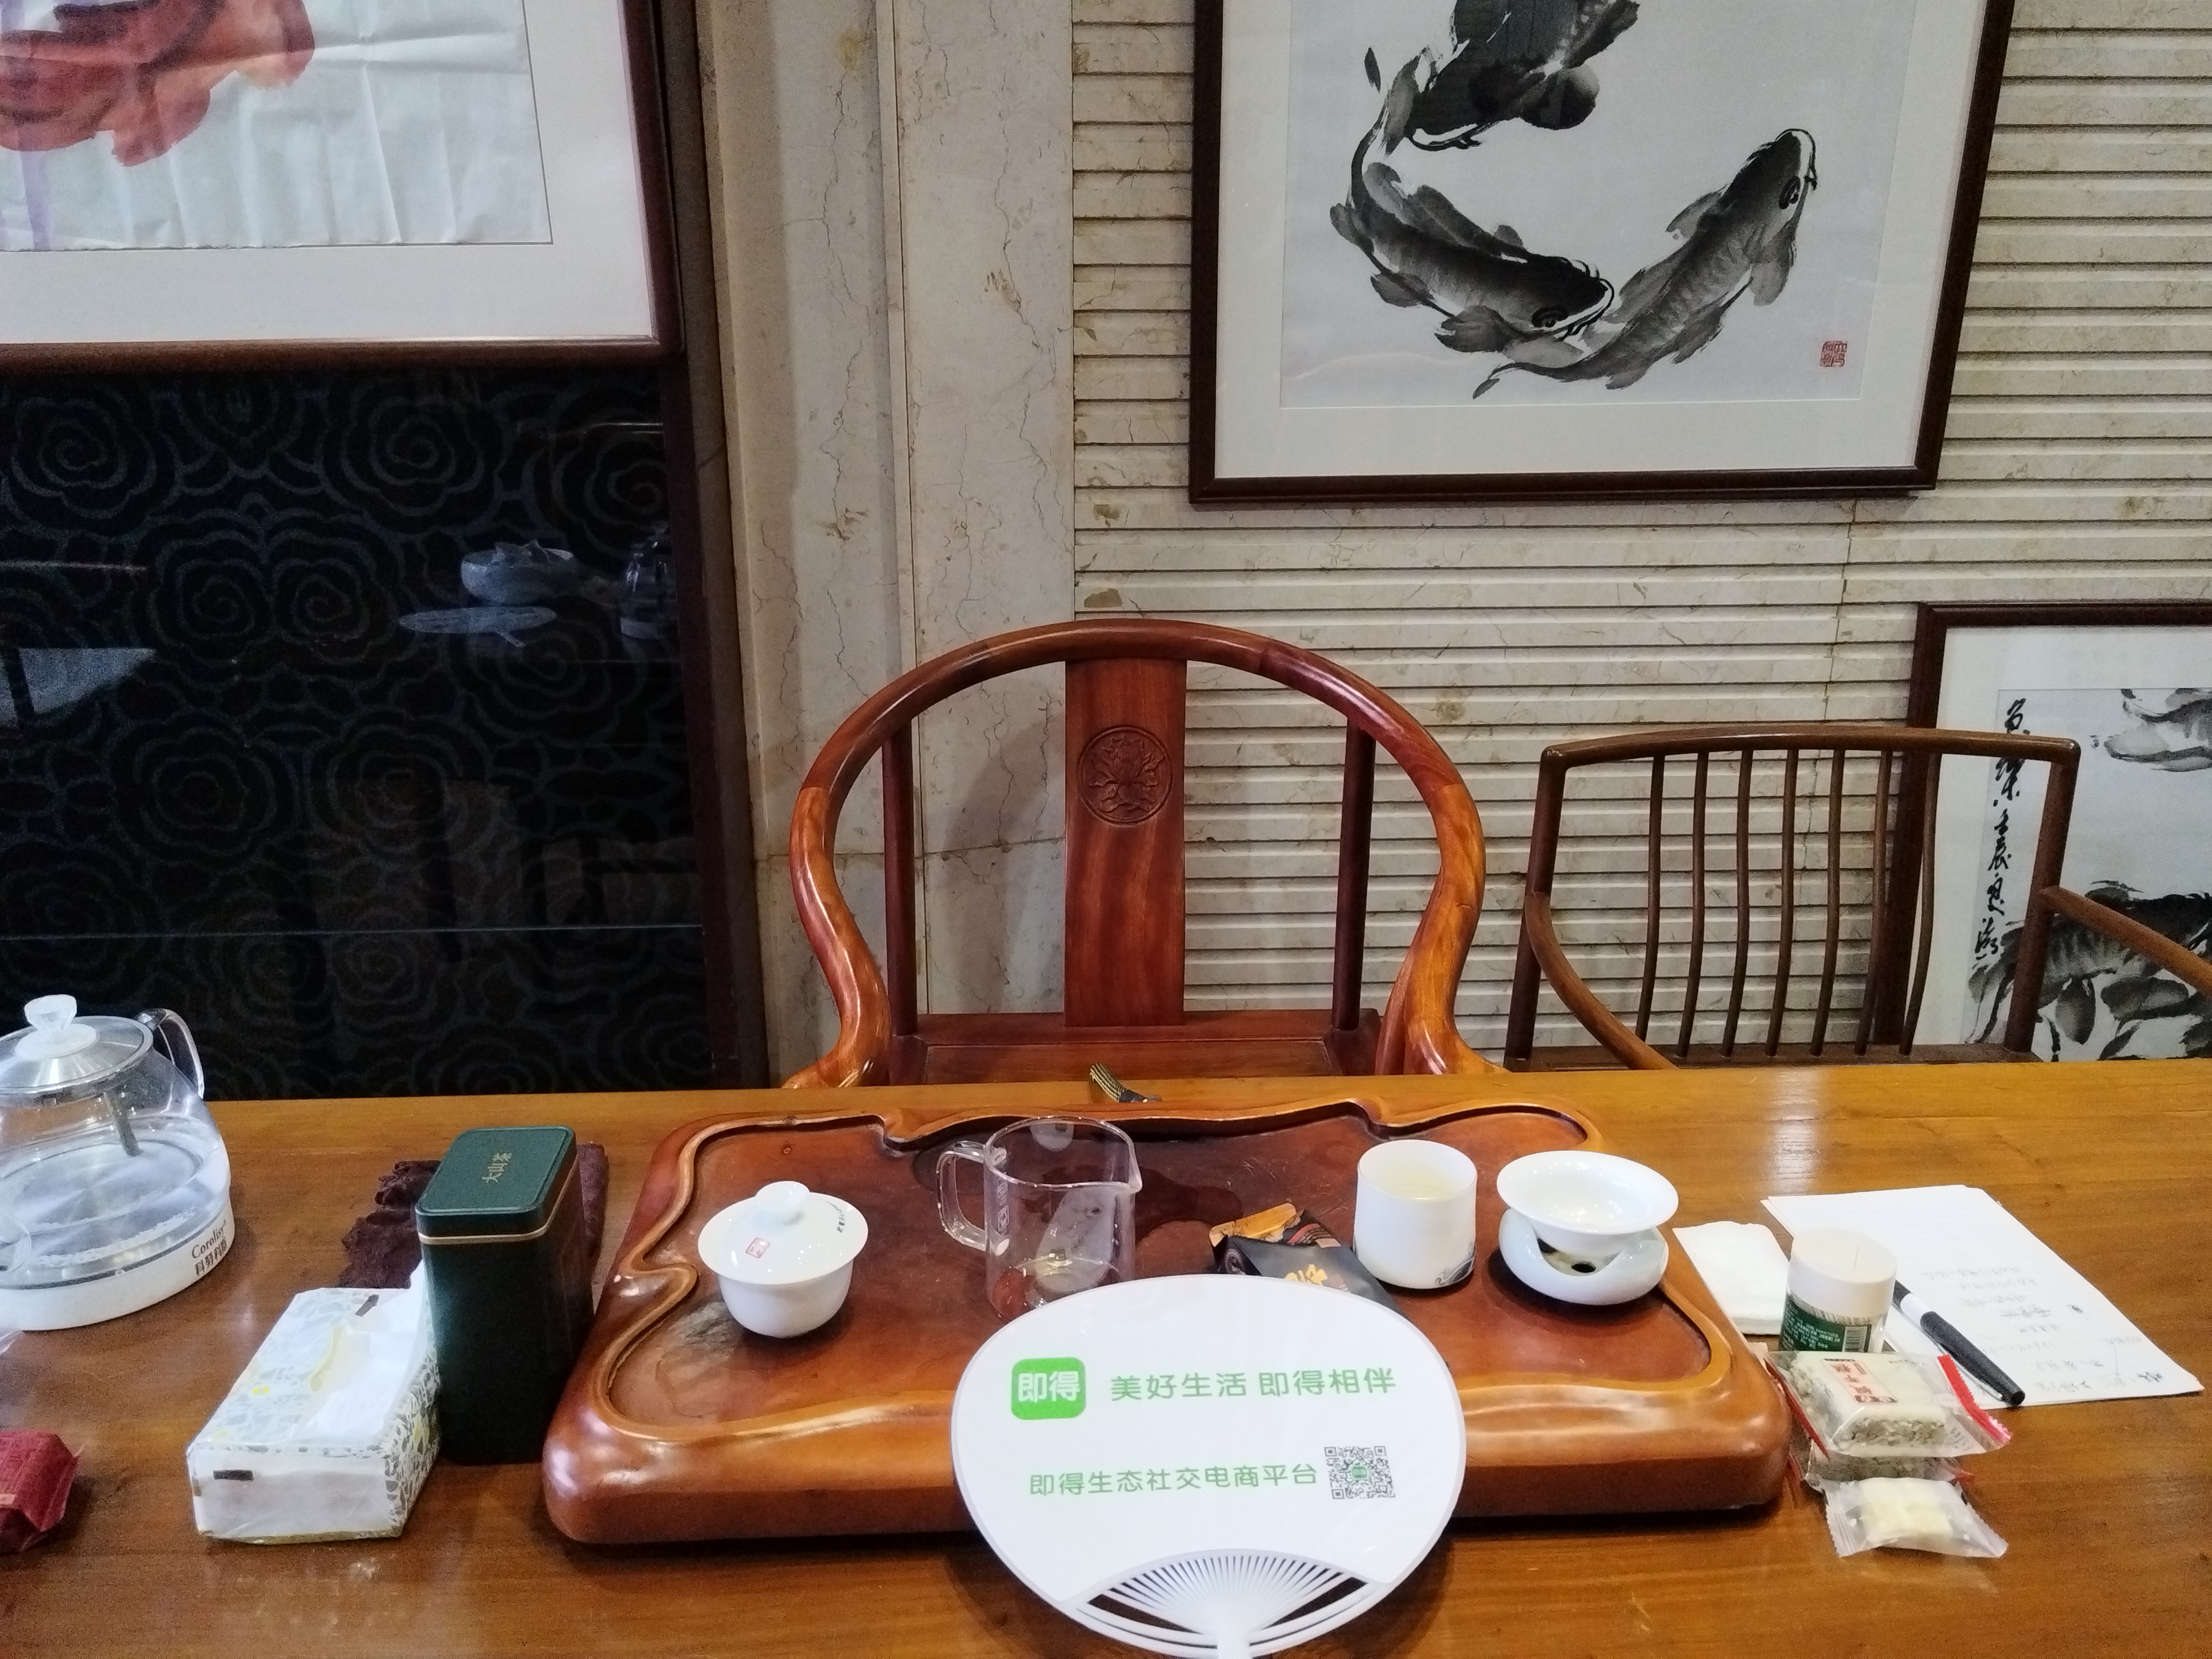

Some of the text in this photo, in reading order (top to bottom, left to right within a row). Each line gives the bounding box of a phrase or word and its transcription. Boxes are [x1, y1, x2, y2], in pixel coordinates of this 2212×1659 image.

[1018, 1370, 1081, 1403] 即得
[1111, 1368, 1396, 1402] 美好生活 即得相伴
[1030, 1463, 1317, 1496] 即得生态社交电商平台
